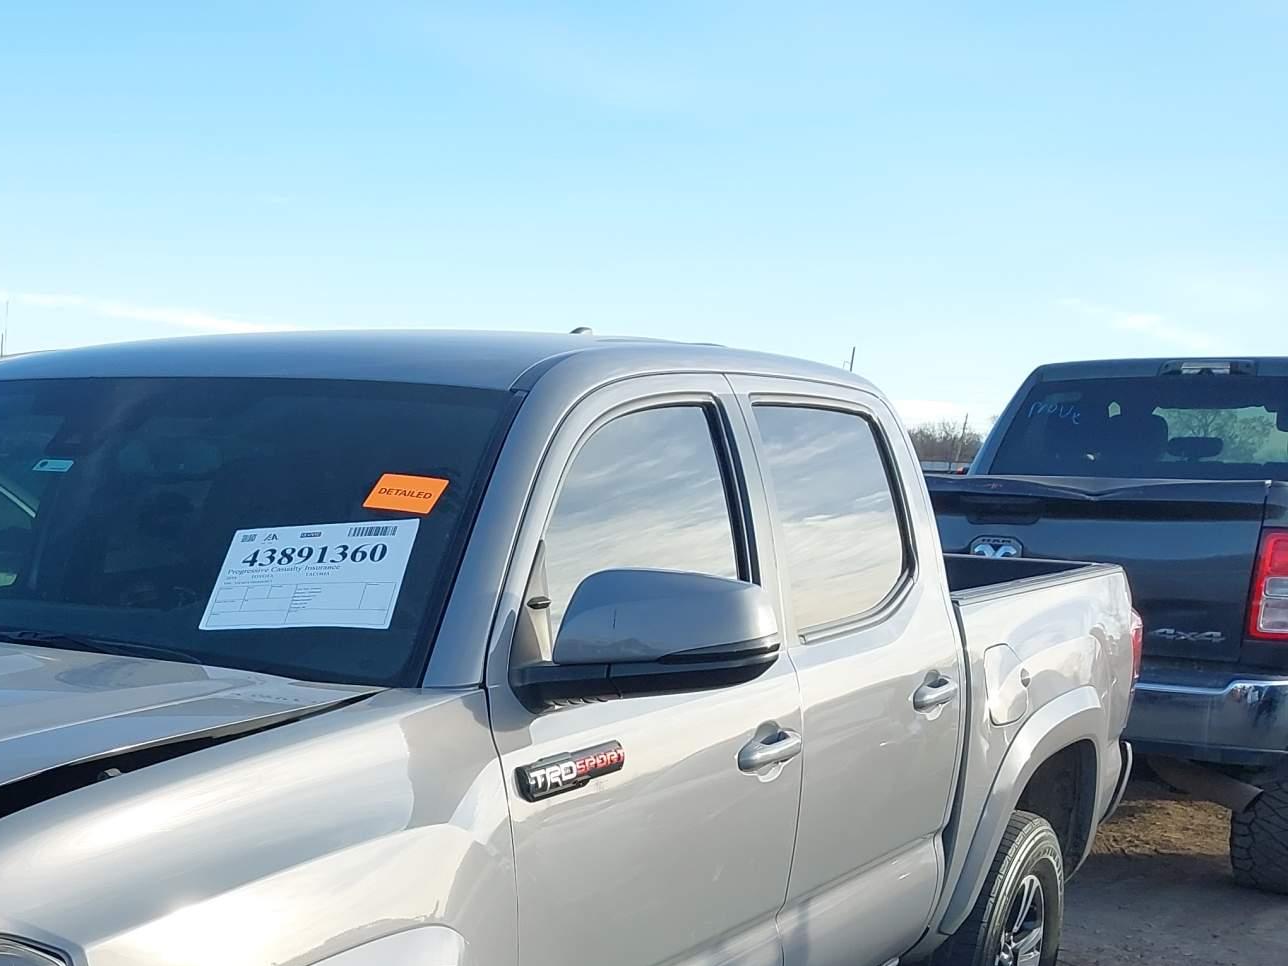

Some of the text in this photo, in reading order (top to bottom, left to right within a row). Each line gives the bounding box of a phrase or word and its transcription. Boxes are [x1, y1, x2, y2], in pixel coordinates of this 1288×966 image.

[377, 487, 433, 500] DETAILED
[241, 543, 388, 567] 43891360
[529, 749, 625, 791] TRD SPORT
